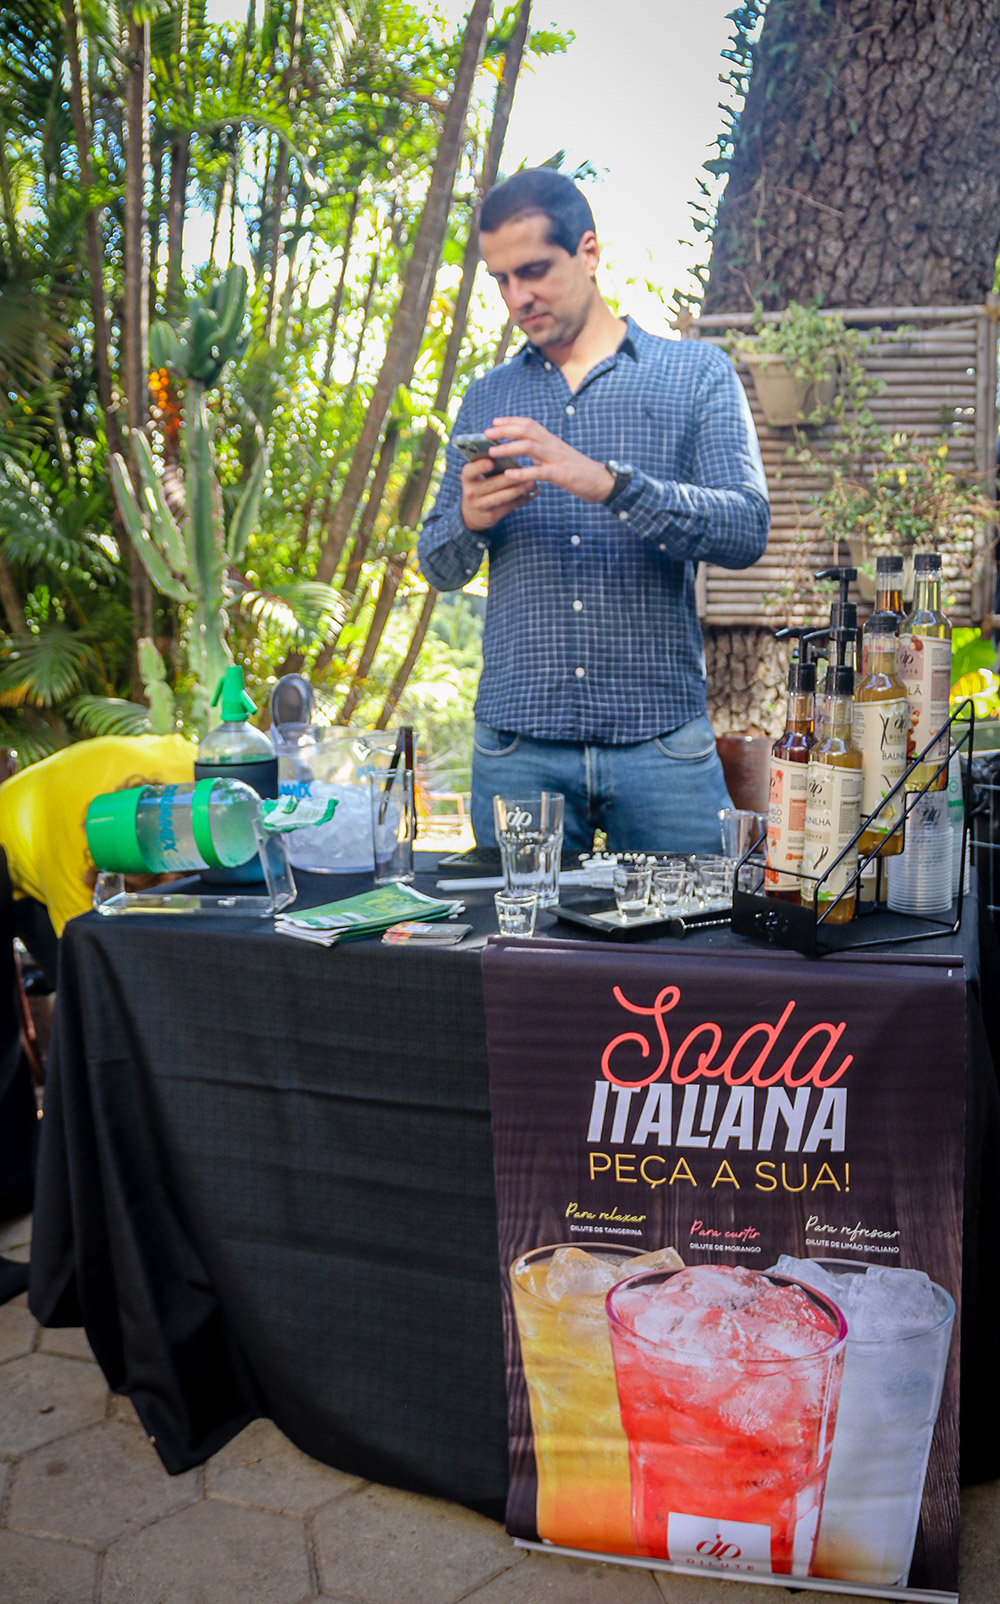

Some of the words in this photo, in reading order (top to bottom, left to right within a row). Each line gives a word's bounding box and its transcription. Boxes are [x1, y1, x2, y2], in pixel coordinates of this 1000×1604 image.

[601, 985, 854, 1088] Soda
[587, 1080, 848, 1152] ITALIANA
[589, 1152, 698, 1189] PEÇA
[711, 1160, 740, 1190] A
[755, 1161, 850, 1192] SUA!
[565, 1202, 597, 1219] Para
[598, 1206, 647, 1223] relaxar
[570, 1224, 593, 1233] DILUTE
[604, 1226, 643, 1236] TANGERINA
[690, 1219, 722, 1237] Para
[724, 1226, 760, 1242] curtir
[805, 1215, 838, 1233] Para
[840, 1221, 901, 1242] refrescar
[689, 1242, 713, 1250] DILUTE
[725, 1245, 762, 1253] MORANGO
[805, 1238, 829, 1247] DILUTE
[830, 1240, 839, 1248] DE
[841, 1241, 863, 1251] LIMÃO
[864, 1244, 900, 1253] SICILIANO
[686, 1557, 754, 1571] DILUTE
